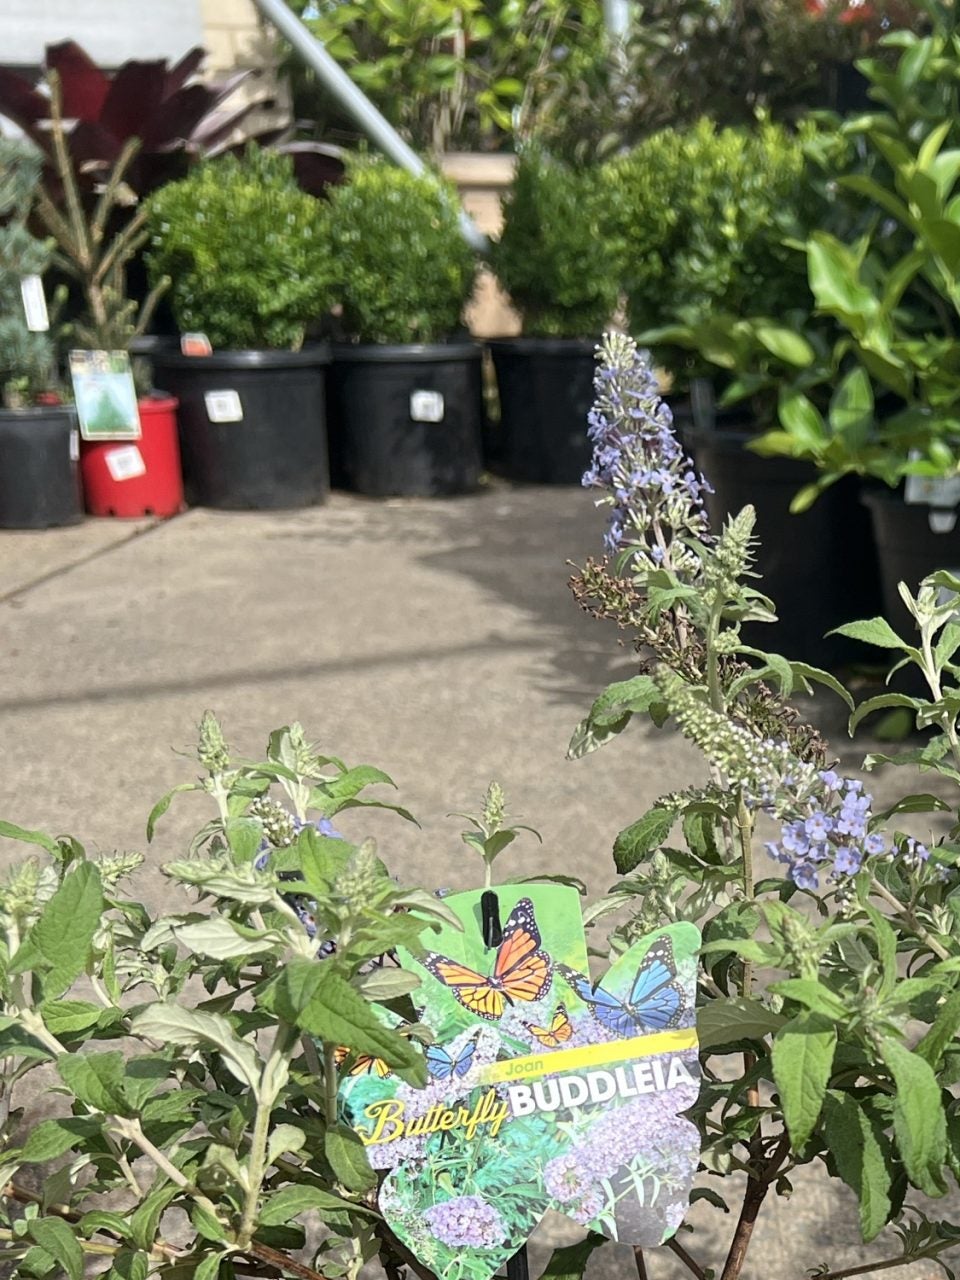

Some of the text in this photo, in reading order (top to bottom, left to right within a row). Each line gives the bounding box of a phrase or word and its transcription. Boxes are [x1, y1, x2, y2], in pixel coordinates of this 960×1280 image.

[505, 1060, 543, 1076] Joan
[353, 1056, 698, 1146] Butterfly BUDDLEIA
